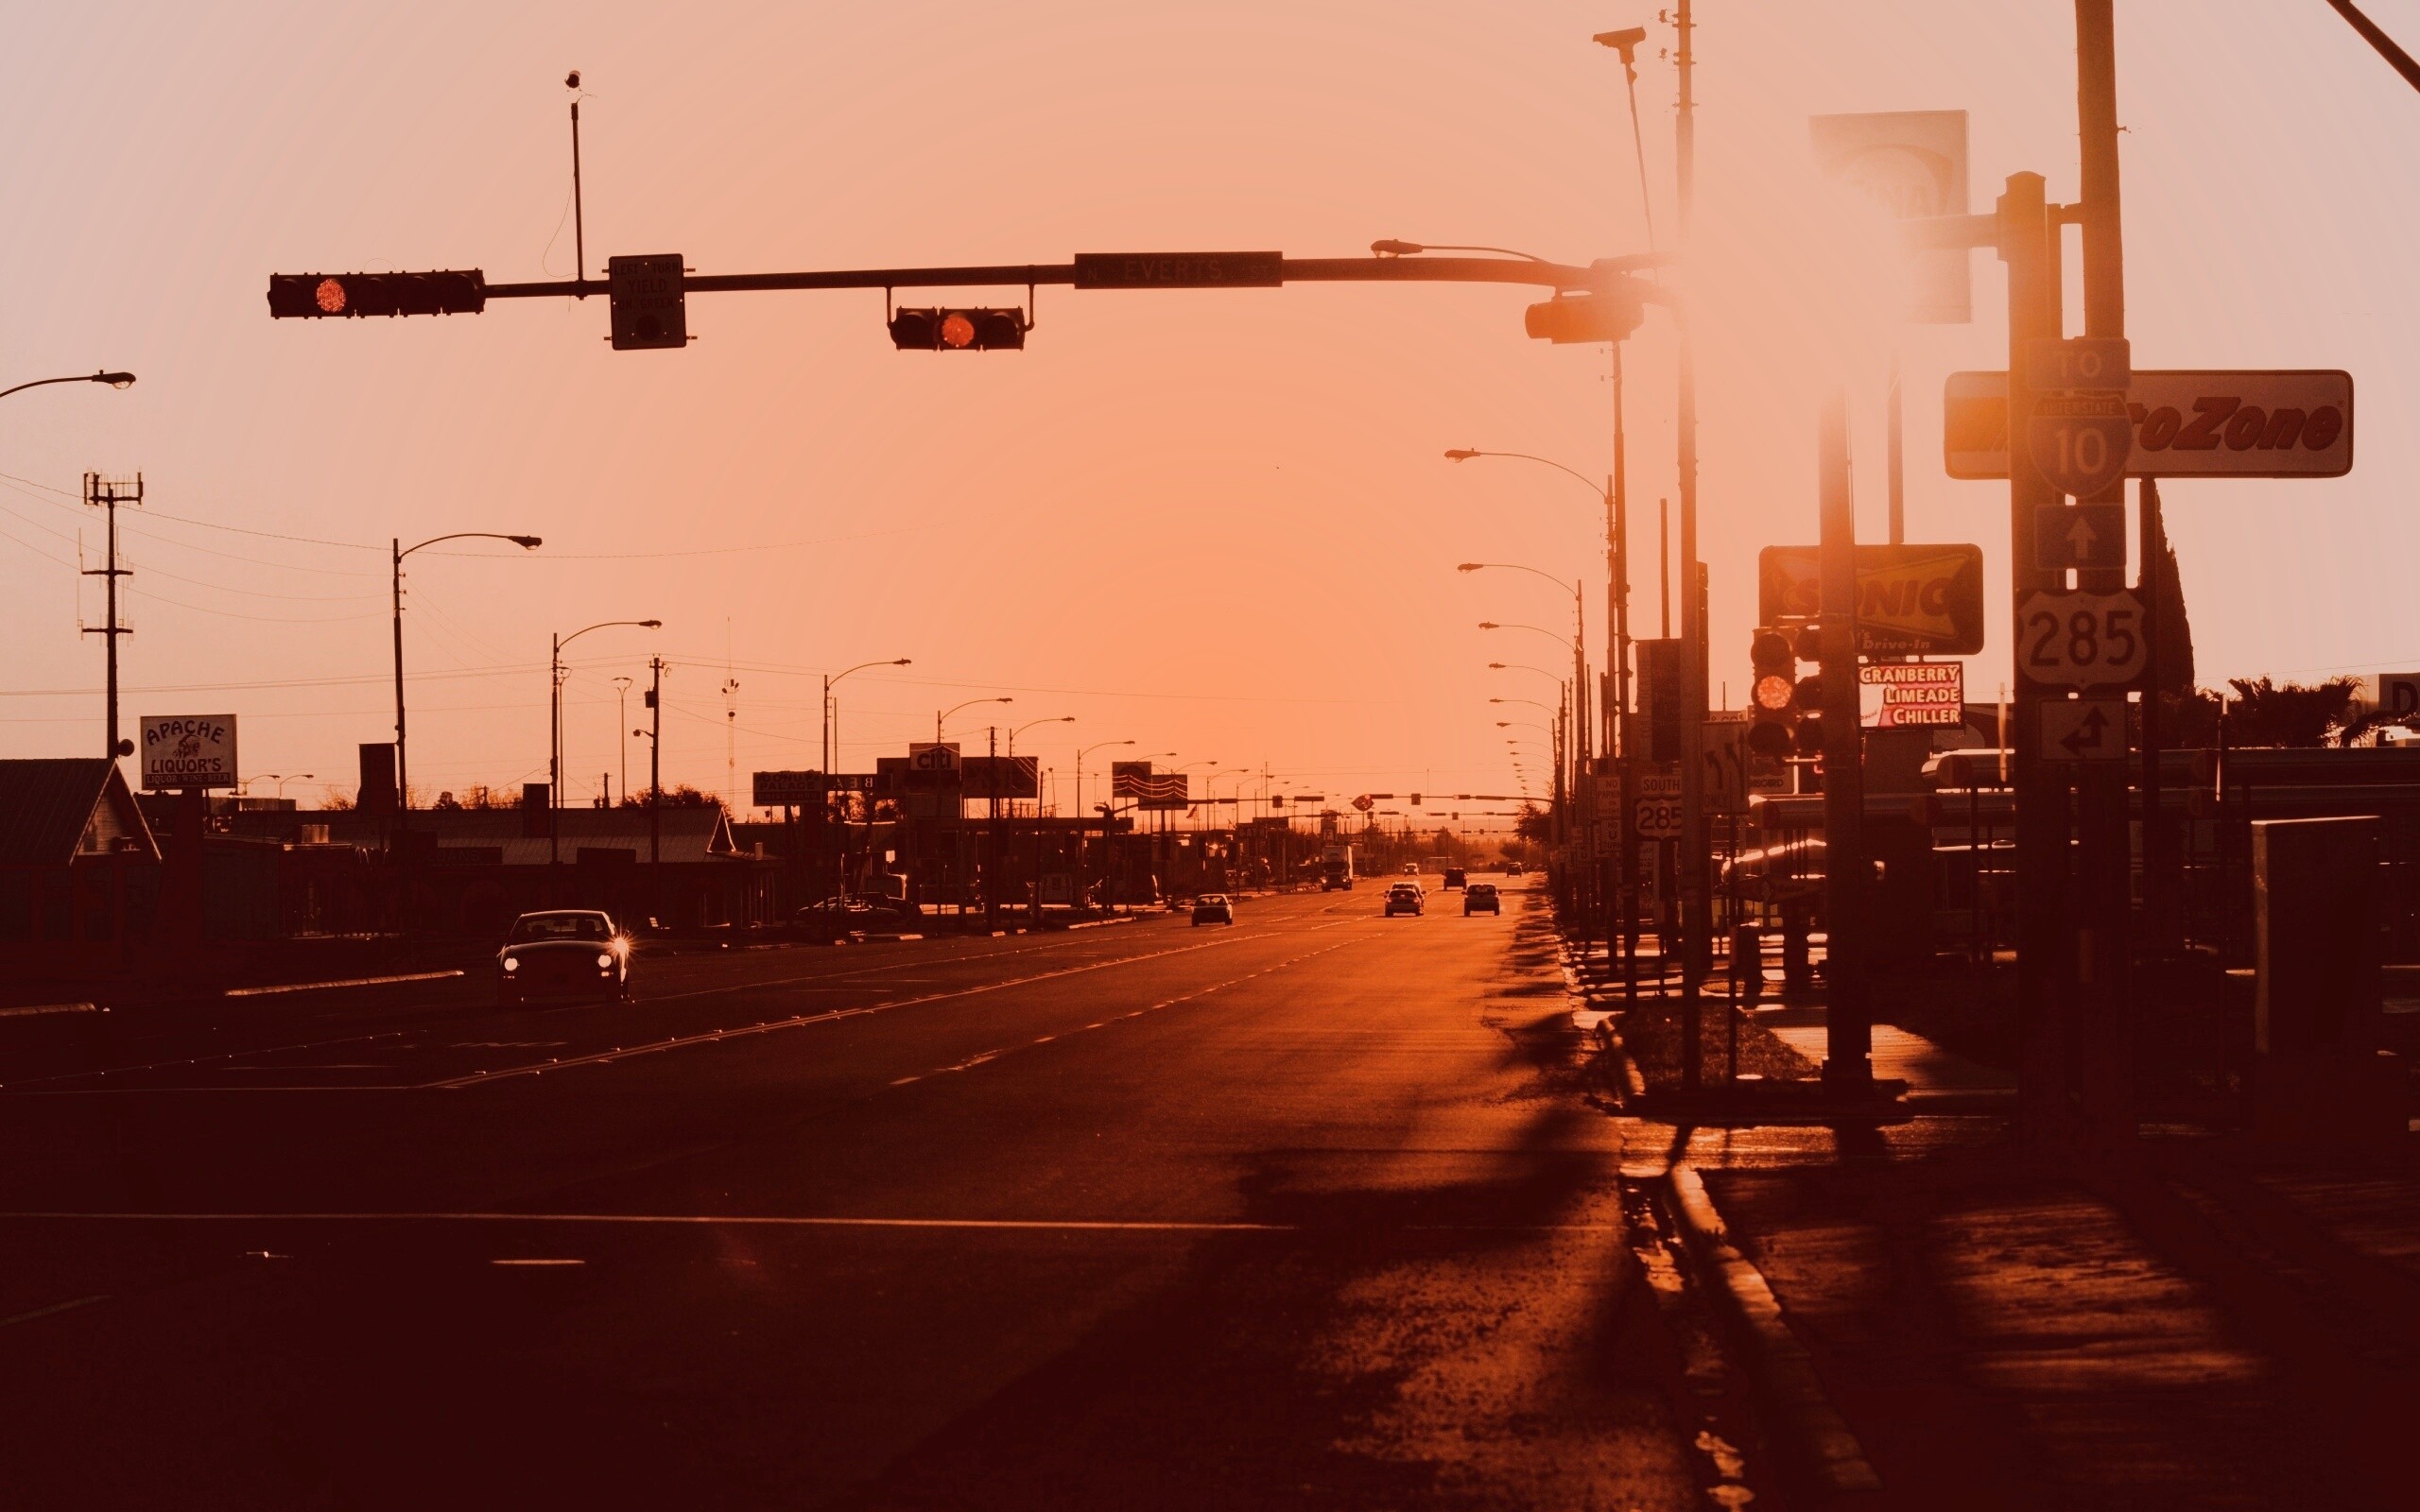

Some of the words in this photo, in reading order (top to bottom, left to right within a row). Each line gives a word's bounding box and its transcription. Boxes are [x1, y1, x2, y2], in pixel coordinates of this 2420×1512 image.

[652, 262, 679, 274] TURN
[1124, 258, 1223, 281] EVERTS
[628, 278, 667, 295] YIELD
[2052, 350, 2103, 378] TO
[2055, 427, 2107, 474] 10
[1783, 576, 1959, 615] SNIC
[1862, 637, 1931, 651] Drive-In
[2028, 610, 2136, 667] 285
[1858, 666, 1960, 684] CRANBERRY
[1885, 687, 1960, 704] LIMEADE
[1893, 708, 1962, 725] CHILLER
[147, 720, 225, 747] APACHE
[151, 757, 222, 774] LIQUOR'S
[917, 751, 952, 769] citi
[147, 775, 178, 785] LIQUOR
[207, 773, 229, 783] BEER
[759, 782, 816, 790] PALACE
[1606, 780, 1618, 788] NO
[1643, 779, 1681, 791] SOUTH
[1598, 790, 1621, 799] PARKIN
[1639, 806, 1682, 831] 285
[1608, 831, 1617, 840] U
